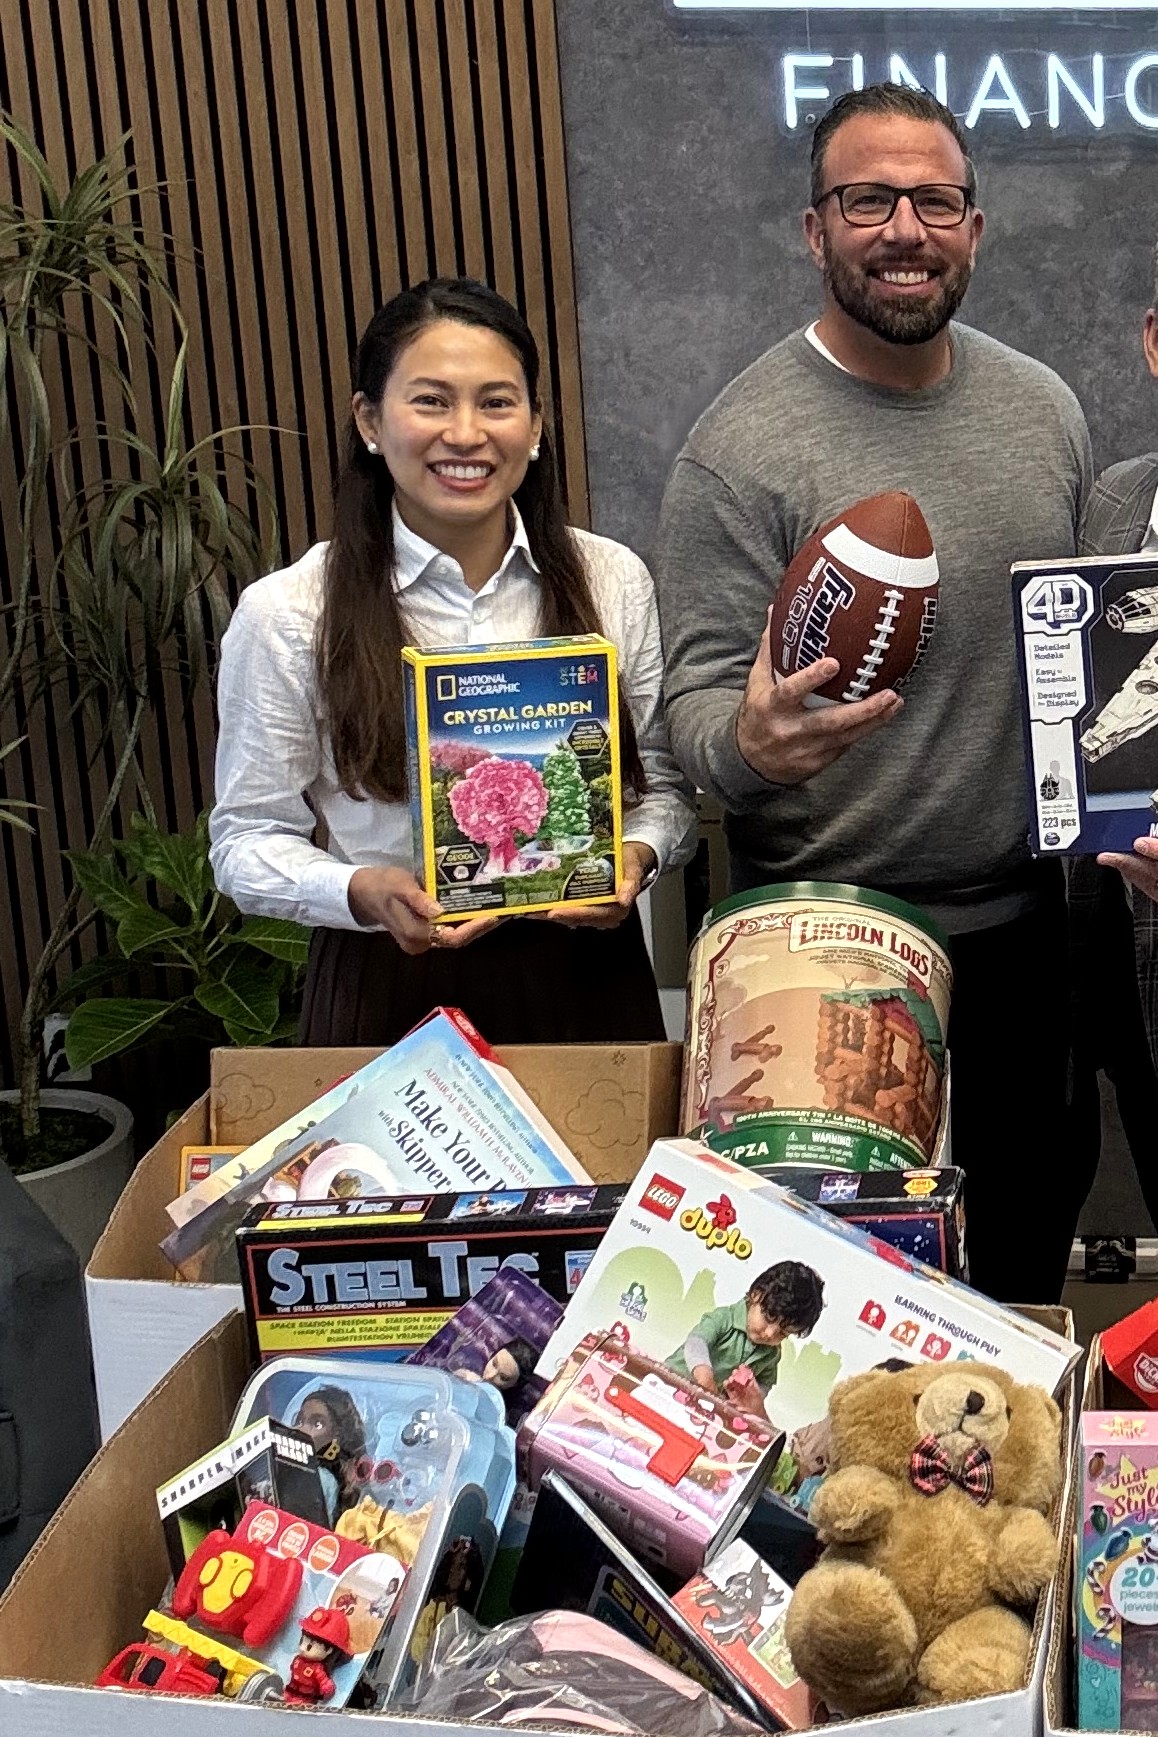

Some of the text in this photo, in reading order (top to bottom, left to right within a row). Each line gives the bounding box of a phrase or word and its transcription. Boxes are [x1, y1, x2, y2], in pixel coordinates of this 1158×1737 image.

[795, 561, 856, 671] Frankli
[458, 673, 507, 686] NATIONAL
[458, 682, 520, 697] GEOGRAPHIC
[559, 670, 598, 686] STEM
[443, 700, 593, 726] CRYSTAL GARDEN
[473, 718, 567, 735] GROWING KIT
[1042, 818, 1077, 829] 223 pcs
[799, 921, 929, 976] LINCOLN LOGS
[423, 1066, 459, 1107] ADMIRAL
[394, 1078, 491, 1185] Make Your
[388, 1120, 451, 1191] Skipper
[721, 1142, 770, 1160] C/PZA
[273, 1199, 391, 1218] STEEL TEC
[648, 1184, 679, 1209] LEGO
[680, 1207, 753, 1260] duplo
[267, 1241, 540, 1305] STEEL TEC
[315, 1302, 376, 1312] CONSTRUCTION
[377, 1300, 406, 1309] SYSTEM
[894, 1295, 937, 1323] LEARNING
[938, 1316, 981, 1347] THROUGH
[161, 1429, 267, 1508] SHARPER IMAGE
[1110, 1466, 1149, 1489] Just
[1127, 1481, 1148, 1497] my
